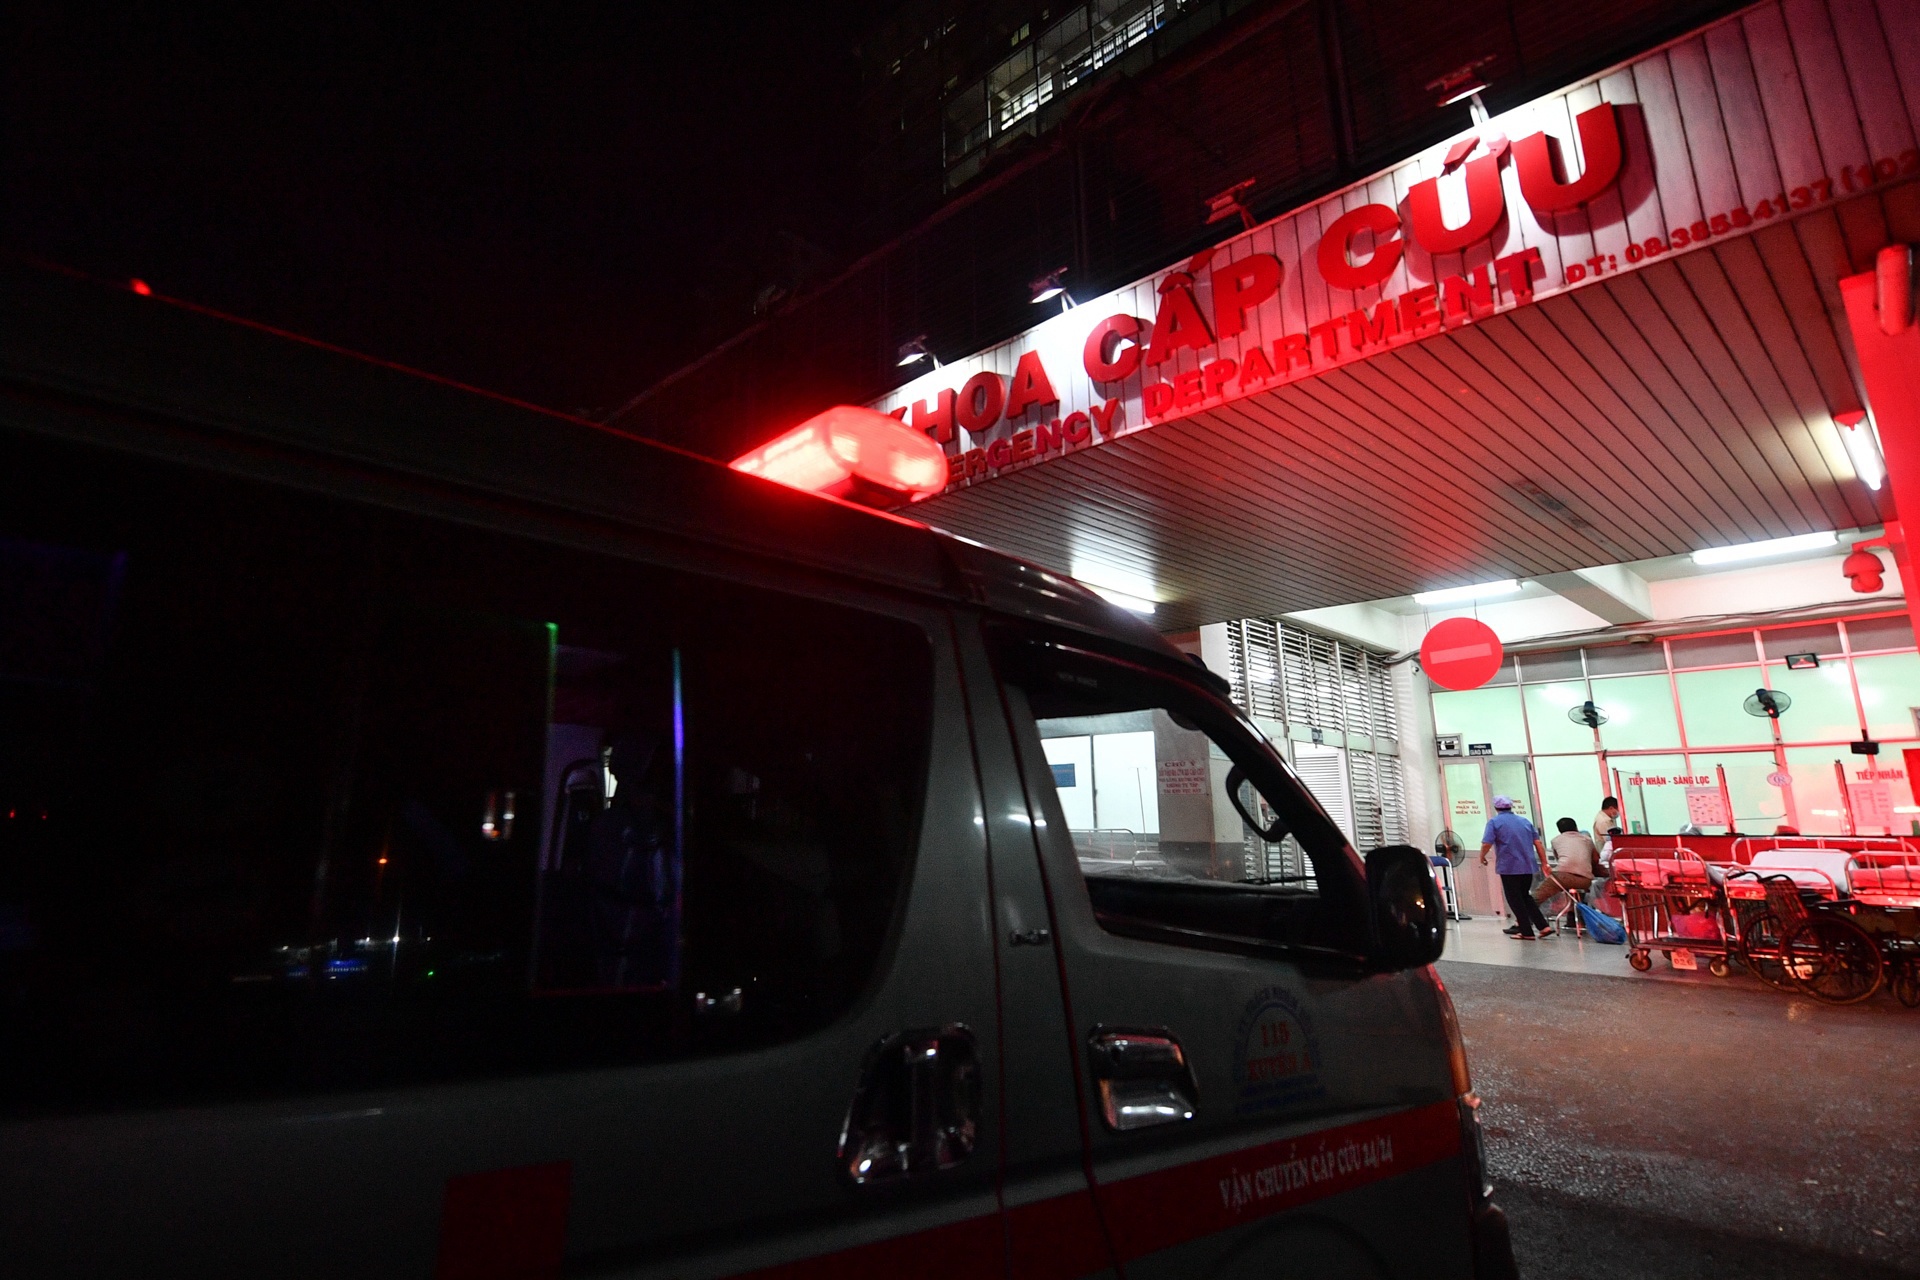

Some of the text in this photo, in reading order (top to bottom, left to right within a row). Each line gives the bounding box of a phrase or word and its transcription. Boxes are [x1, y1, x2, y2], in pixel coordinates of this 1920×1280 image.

[1083, 247, 1284, 383] CẤP
[1316, 101, 1624, 291] CỨU
[946, 397, 1117, 486] ERGENCY
[1143, 246, 1544, 419] DEPARTMENT
[1628, 777, 1644, 786] TIẾP
[1645, 775, 1667, 787] NHẬN
[1673, 775, 1694, 785] SÀNG
[1695, 776, 1710, 786] LỌC
[1856, 768, 1904, 782] TIẾP NHẬN
[1255, 1141, 1310, 1199] CHUYỂN
